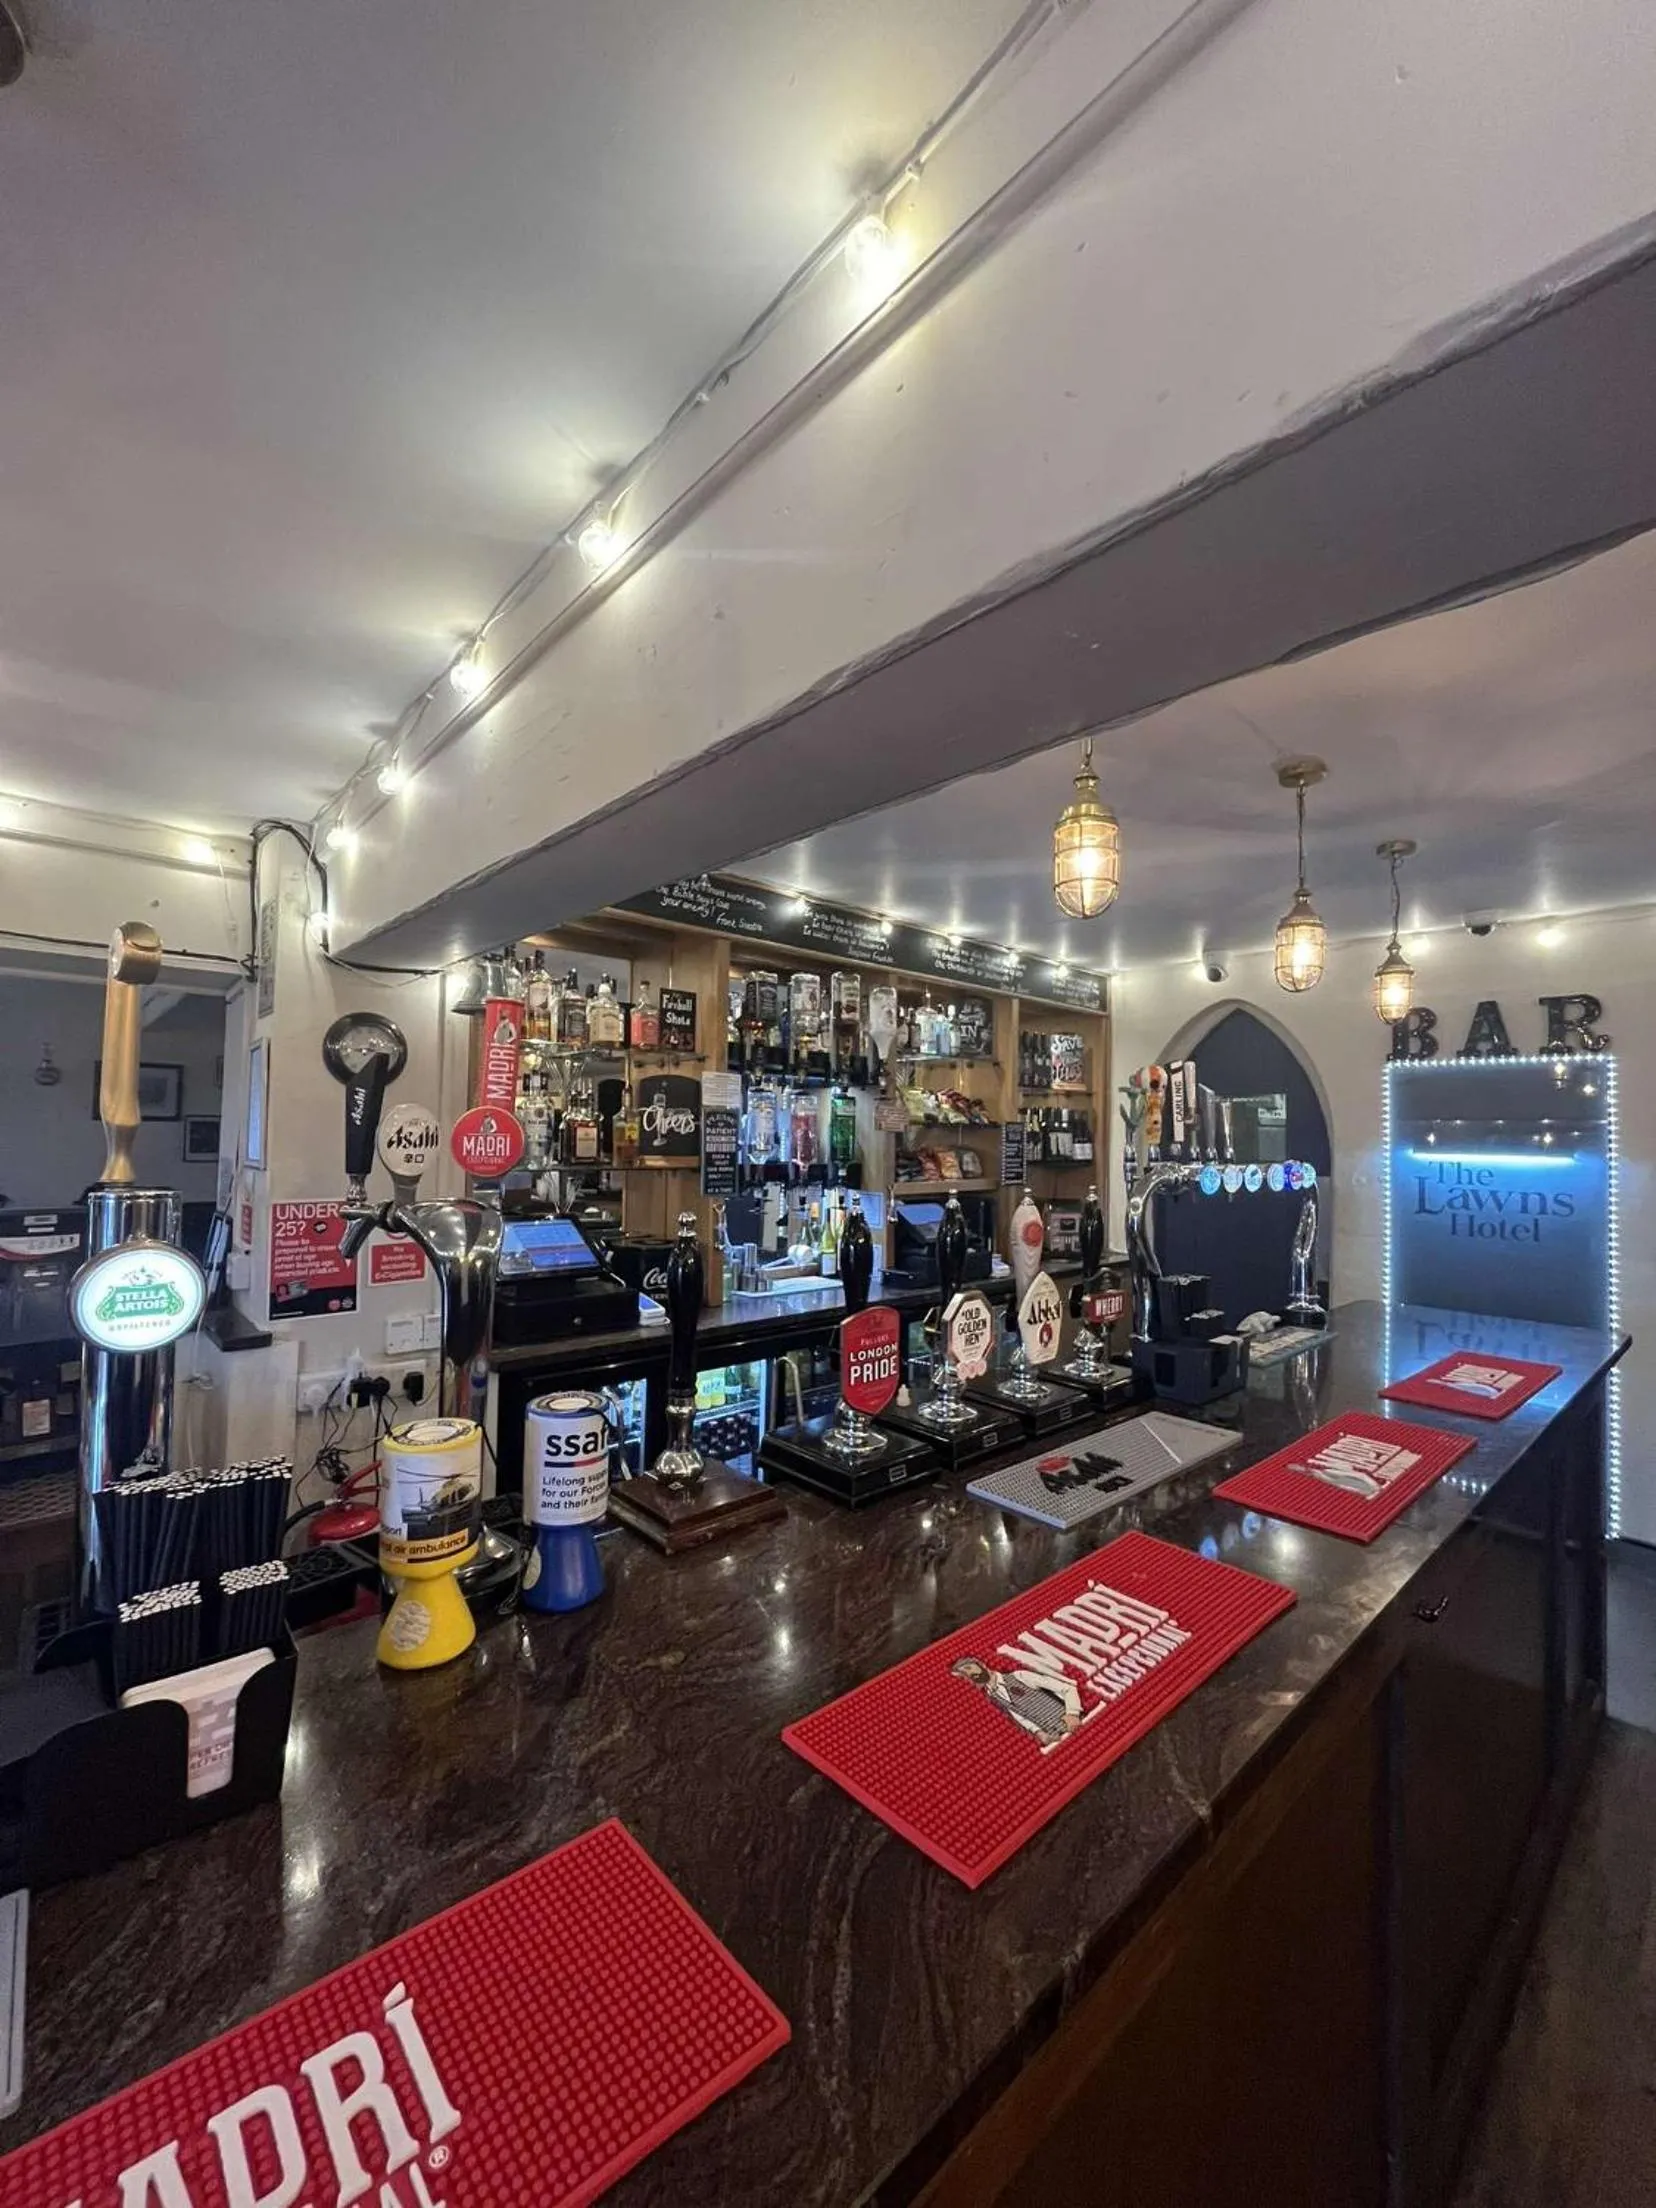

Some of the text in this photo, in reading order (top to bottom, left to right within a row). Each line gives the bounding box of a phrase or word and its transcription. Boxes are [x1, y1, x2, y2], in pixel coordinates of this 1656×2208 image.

[1388, 994, 1610, 1061] BAR
[350, 1087, 366, 1126] Asahi
[641, 1105, 696, 1134] Cheers
[386, 1125, 439, 1151] Asahi
[1428, 1161, 1494, 1187] The
[1414, 1175, 1575, 1218] Lawns
[276, 1203, 339, 1220] UNDER
[275, 1221, 306, 1237] 25?
[1450, 1214, 1540, 1243] Hotel
[115, 1288, 168, 1303] STELLA
[114, 1299, 168, 1313] ARTOIS
[958, 1319, 987, 1336] GOLDEN
[849, 1342, 898, 1362] LONDON
[850, 1355, 898, 1386] PRIDE
[542, 1475, 585, 1488] Lifelong
[541, 1487, 556, 1498] for
[559, 1489, 578, 1498] our
[541, 1500, 561, 1509] and
[564, 1498, 588, 1509] their
[409, 1535, 466, 1554] ambulance
